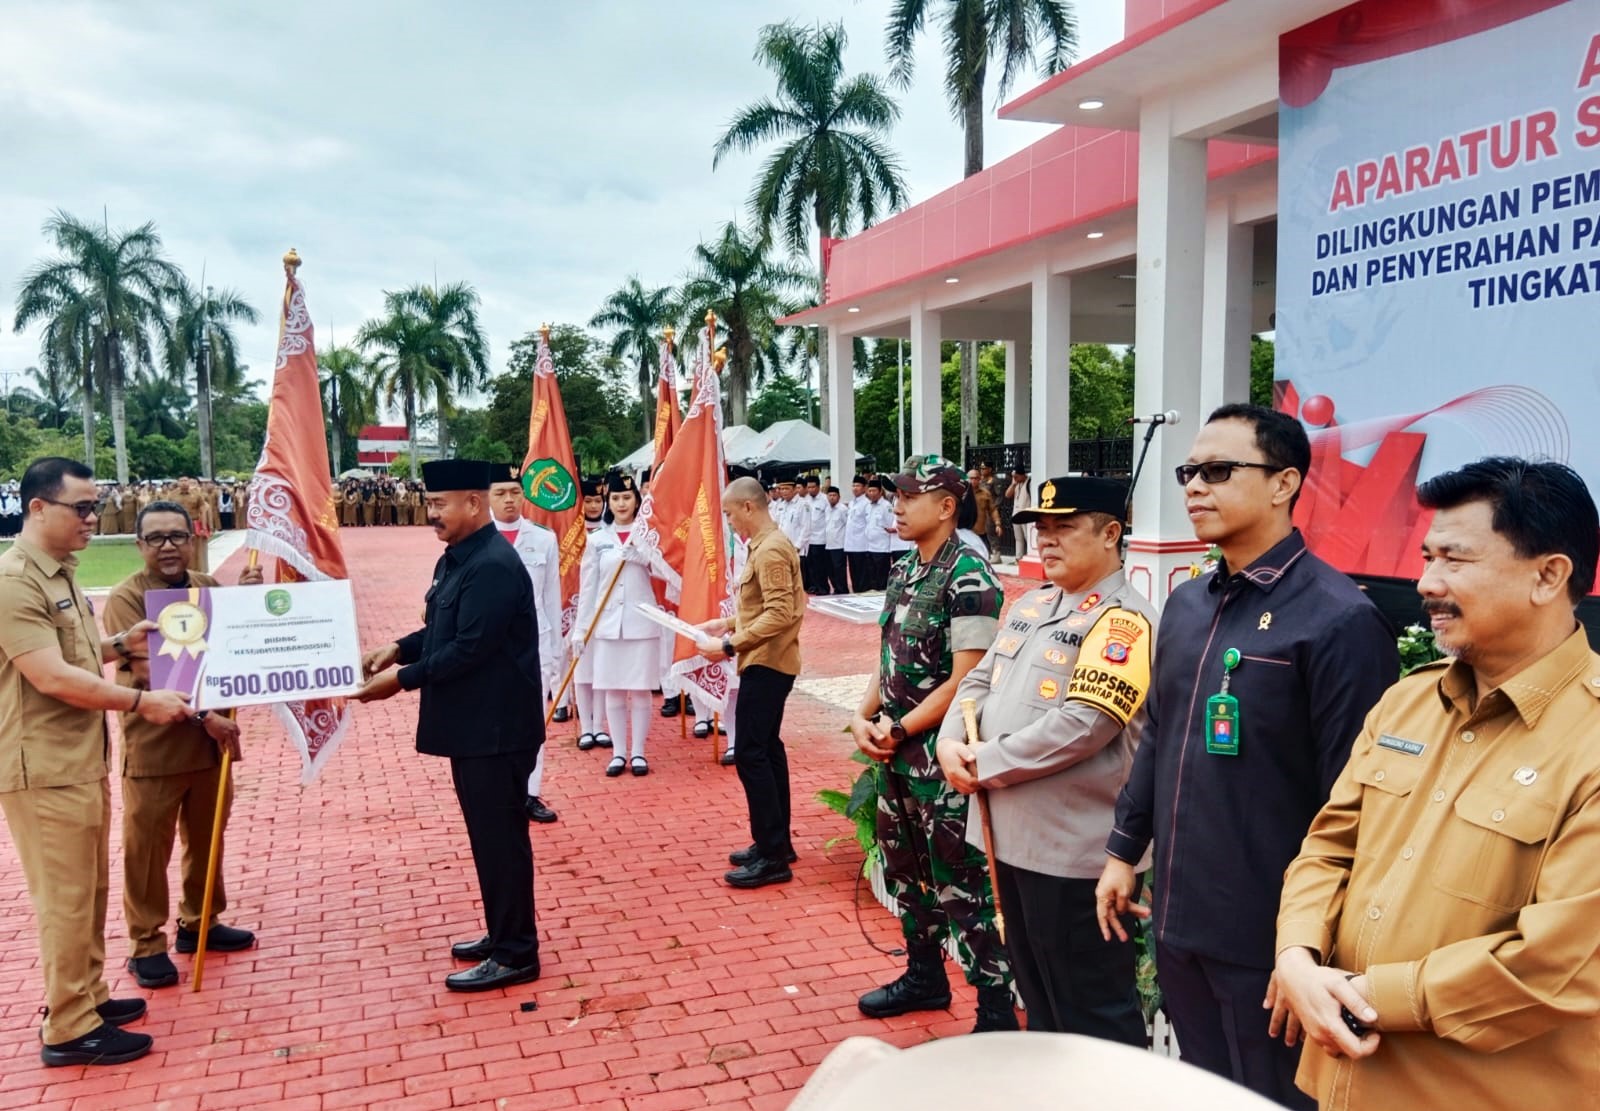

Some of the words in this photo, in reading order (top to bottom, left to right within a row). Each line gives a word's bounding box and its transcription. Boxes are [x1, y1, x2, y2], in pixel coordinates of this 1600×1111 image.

[1330, 110, 1559, 212] APARATUR
[1576, 95, 1600, 147] S
[1316, 188, 1521, 260] DILINGKUNGAN
[1312, 263, 1358, 296] DAN
[1366, 222, 1560, 286] PENYERAHAN
[179, 620, 188, 633] 1
[1009, 620, 1032, 633] HERI
[1072, 668, 1139, 704] KAOPSRES
[1079, 682, 1113, 700] MANTAP
